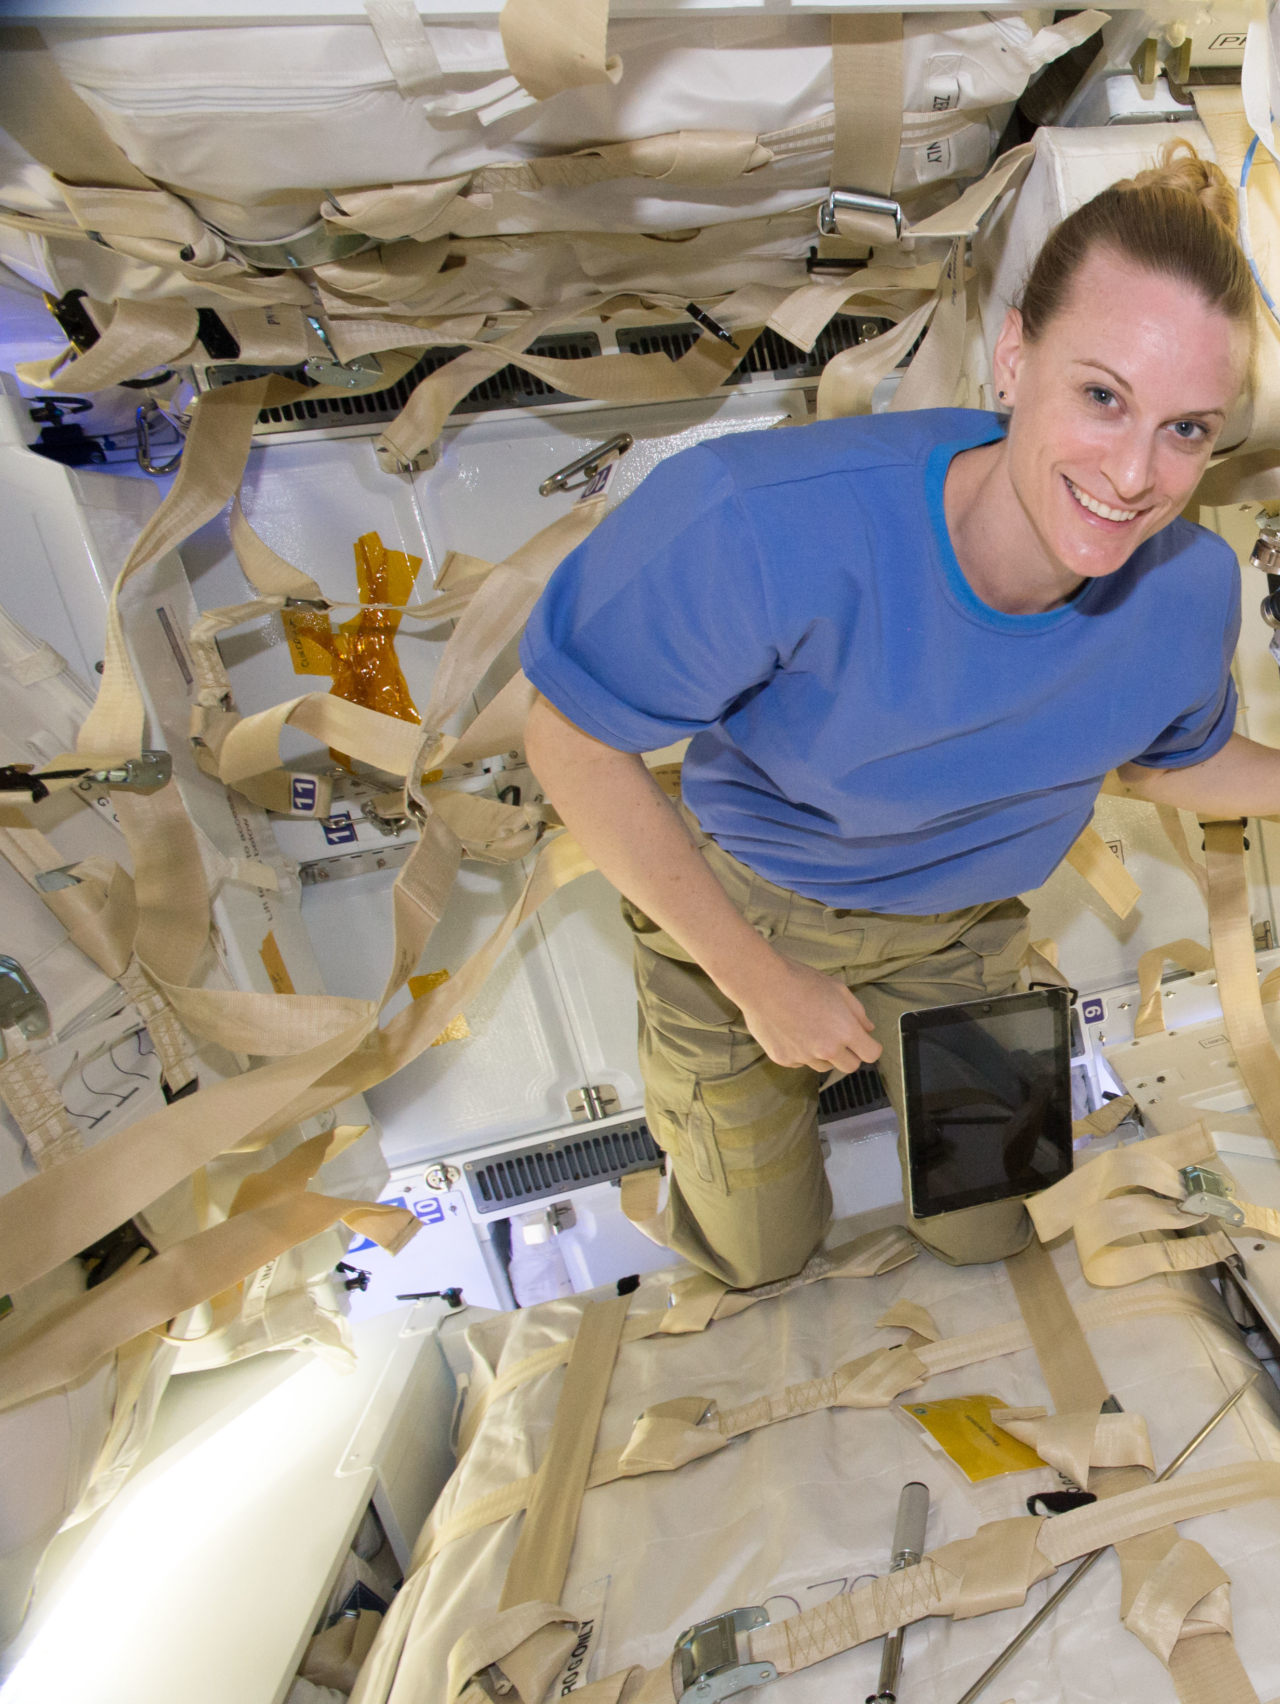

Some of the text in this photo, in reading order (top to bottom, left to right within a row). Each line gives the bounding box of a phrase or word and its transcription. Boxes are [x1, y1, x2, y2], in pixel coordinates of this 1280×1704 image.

[933, 95, 951, 112] ZE
[926, 141, 942, 163] NLY
[294, 782, 314, 808] 11
[1084, 1005, 1101, 1018] 9
[415, 1200, 442, 1224] 10
[571, 1619, 594, 1656] ONLY
